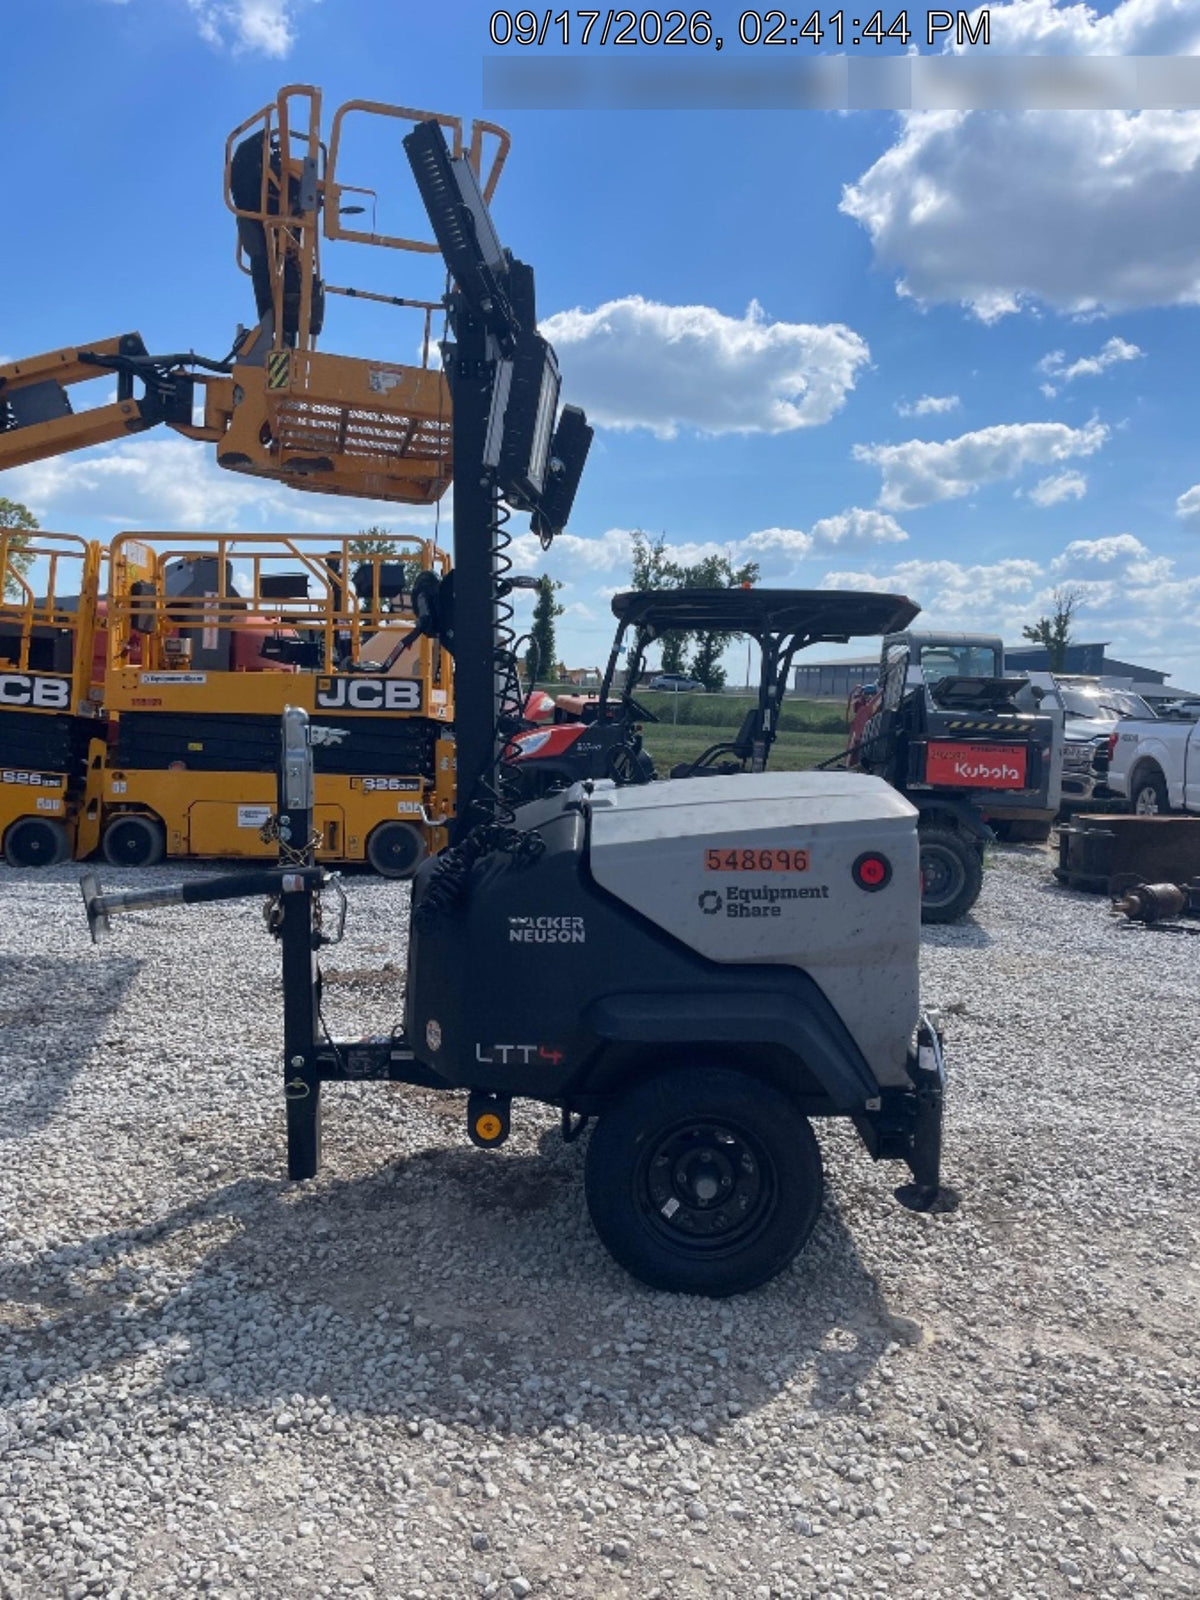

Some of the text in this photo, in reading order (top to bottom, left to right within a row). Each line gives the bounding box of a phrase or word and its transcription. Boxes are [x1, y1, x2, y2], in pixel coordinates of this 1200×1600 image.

[318, 679, 420, 708] JCB
[955, 762, 1019, 779] Kubota
[707, 849, 807, 872] 548696
[726, 885, 829, 903] Equipment
[726, 903, 781, 918] Share
[509, 929, 586, 943] NEUSON
[476, 1043, 562, 1065] LTT4
